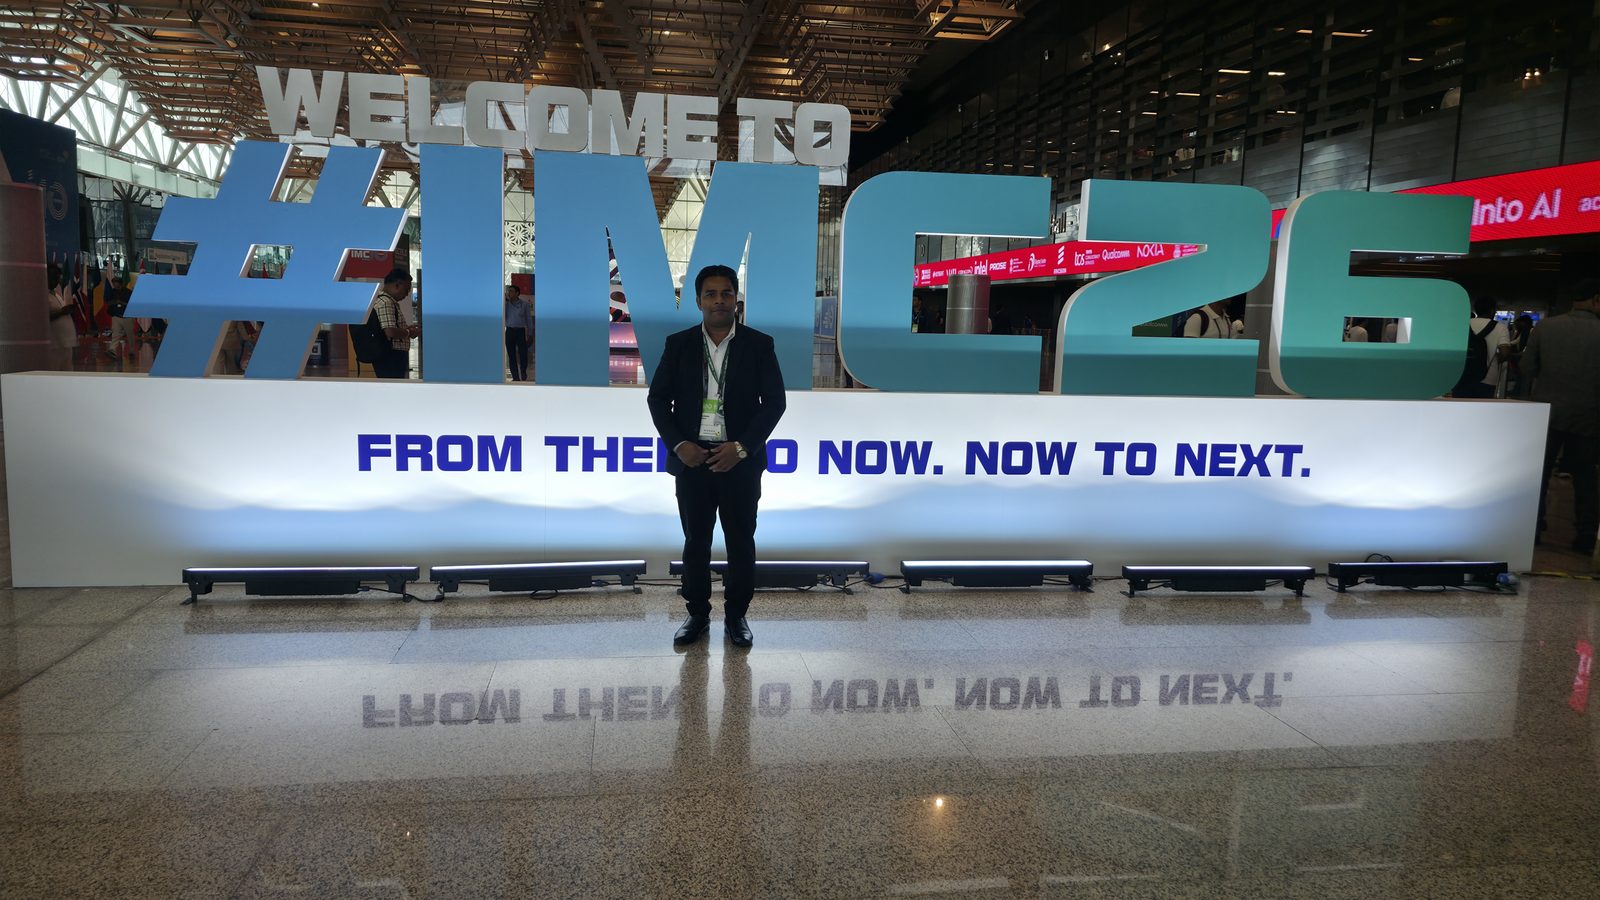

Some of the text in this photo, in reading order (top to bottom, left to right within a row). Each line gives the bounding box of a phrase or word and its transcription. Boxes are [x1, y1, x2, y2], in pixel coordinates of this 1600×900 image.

[256, 66, 851, 166] WELCOME TO
[1528, 187, 1562, 220] AI
[351, 250, 370, 258] IMC
[974, 258, 988, 275] intel
[1136, 243, 1165, 258] NOKIA
[125, 140, 1472, 399] #IMC26
[357, 434, 522, 472] FROM
[766, 438, 798, 474] O
[818, 440, 944, 475] NOW.
[965, 441, 1077, 476] NOW
[1094, 442, 1157, 476] TO
[1174, 443, 1311, 478] NEXT.
